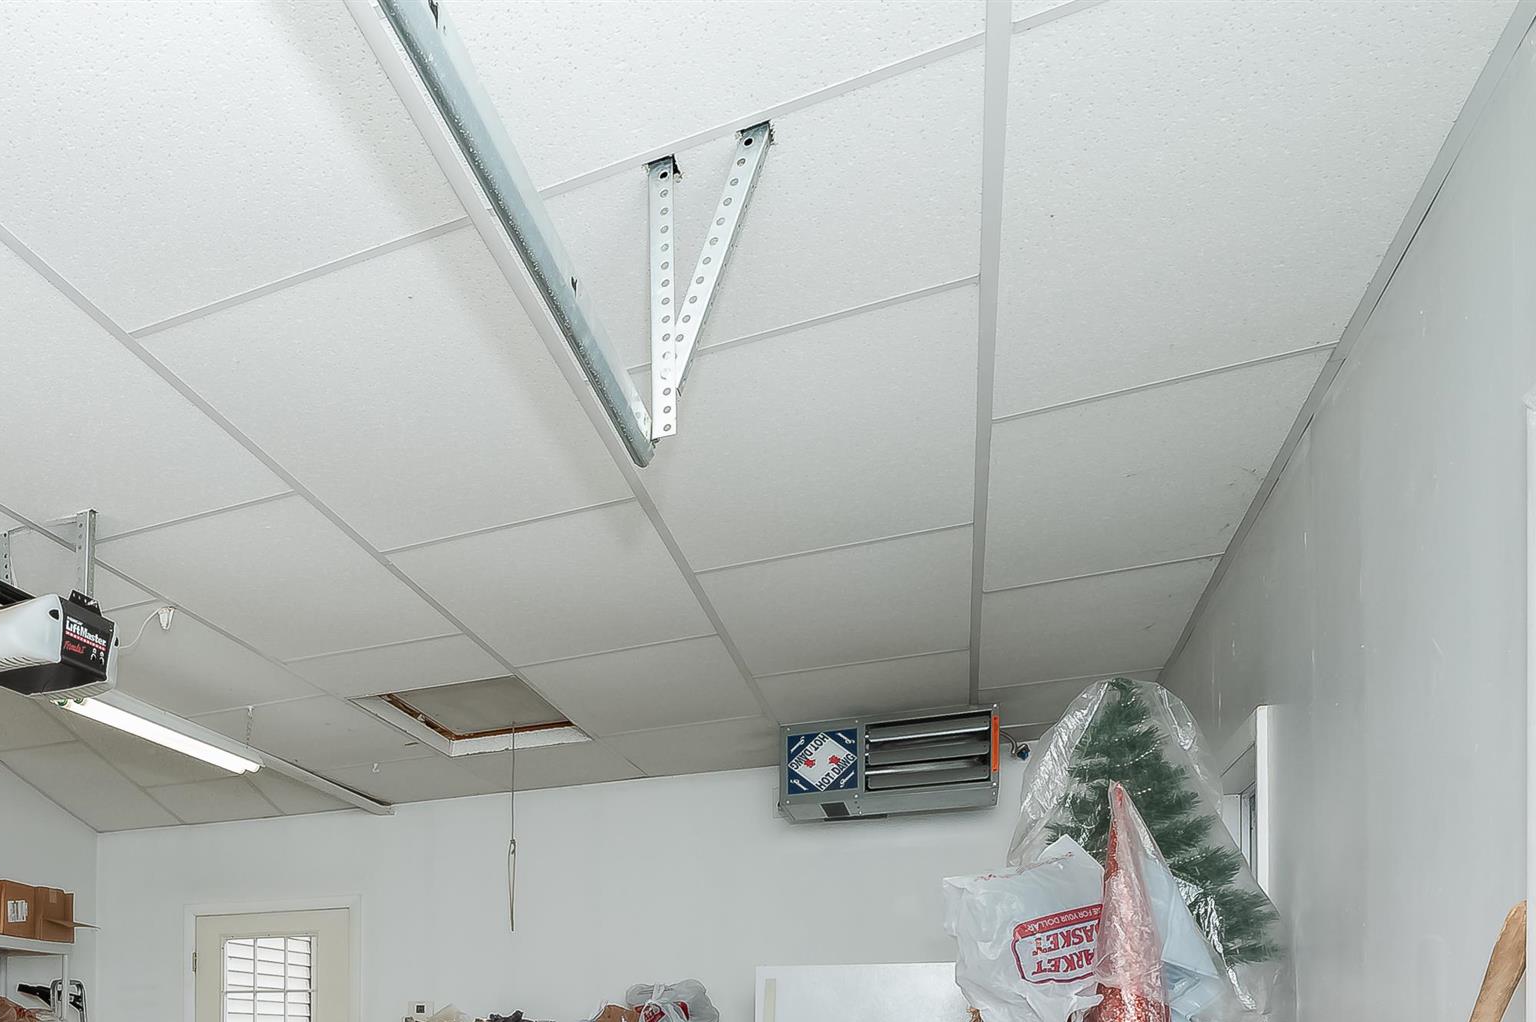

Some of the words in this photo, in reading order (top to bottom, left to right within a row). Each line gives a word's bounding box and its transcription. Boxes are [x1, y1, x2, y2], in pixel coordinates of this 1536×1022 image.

[65, 620, 107, 646] LiftMaster
[1032, 922, 1100, 956] ASKET
[1032, 948, 1095, 976] ARKET
